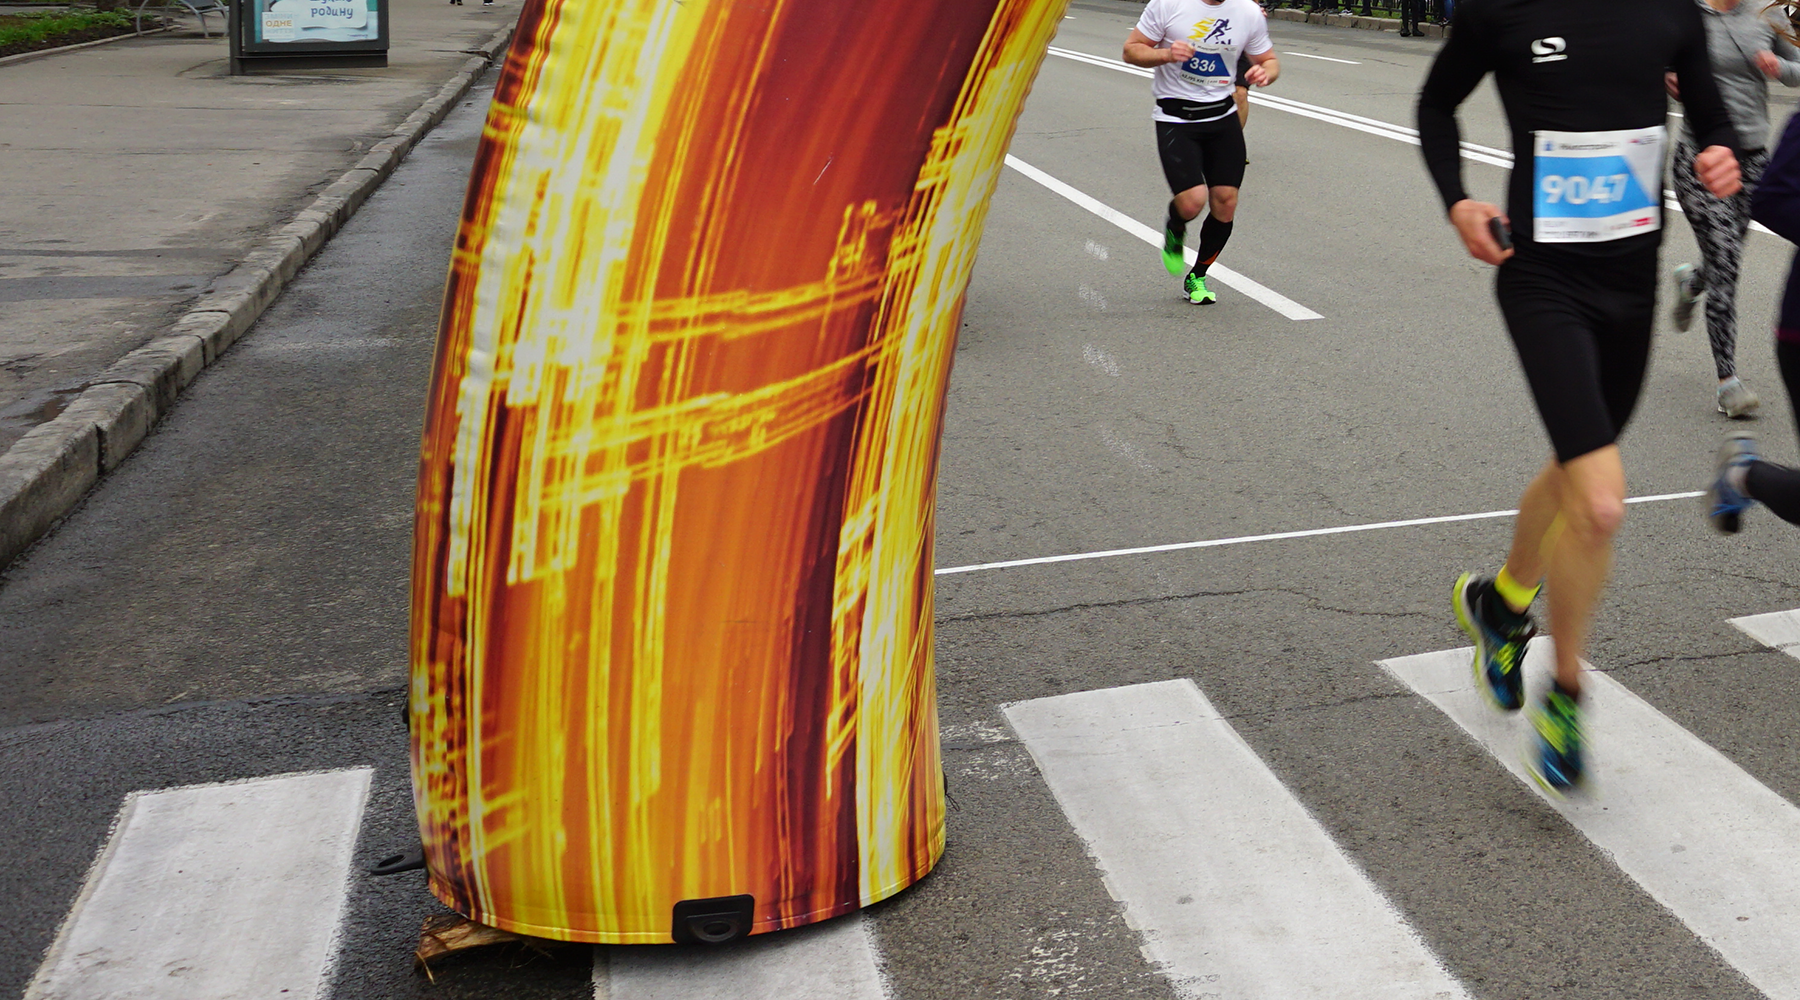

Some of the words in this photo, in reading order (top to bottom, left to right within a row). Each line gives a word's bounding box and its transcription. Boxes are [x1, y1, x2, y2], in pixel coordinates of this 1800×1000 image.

[311, 6, 354, 19] родину
[1189, 57, 1216, 72] 336
[1541, 173, 1629, 205] 9047
